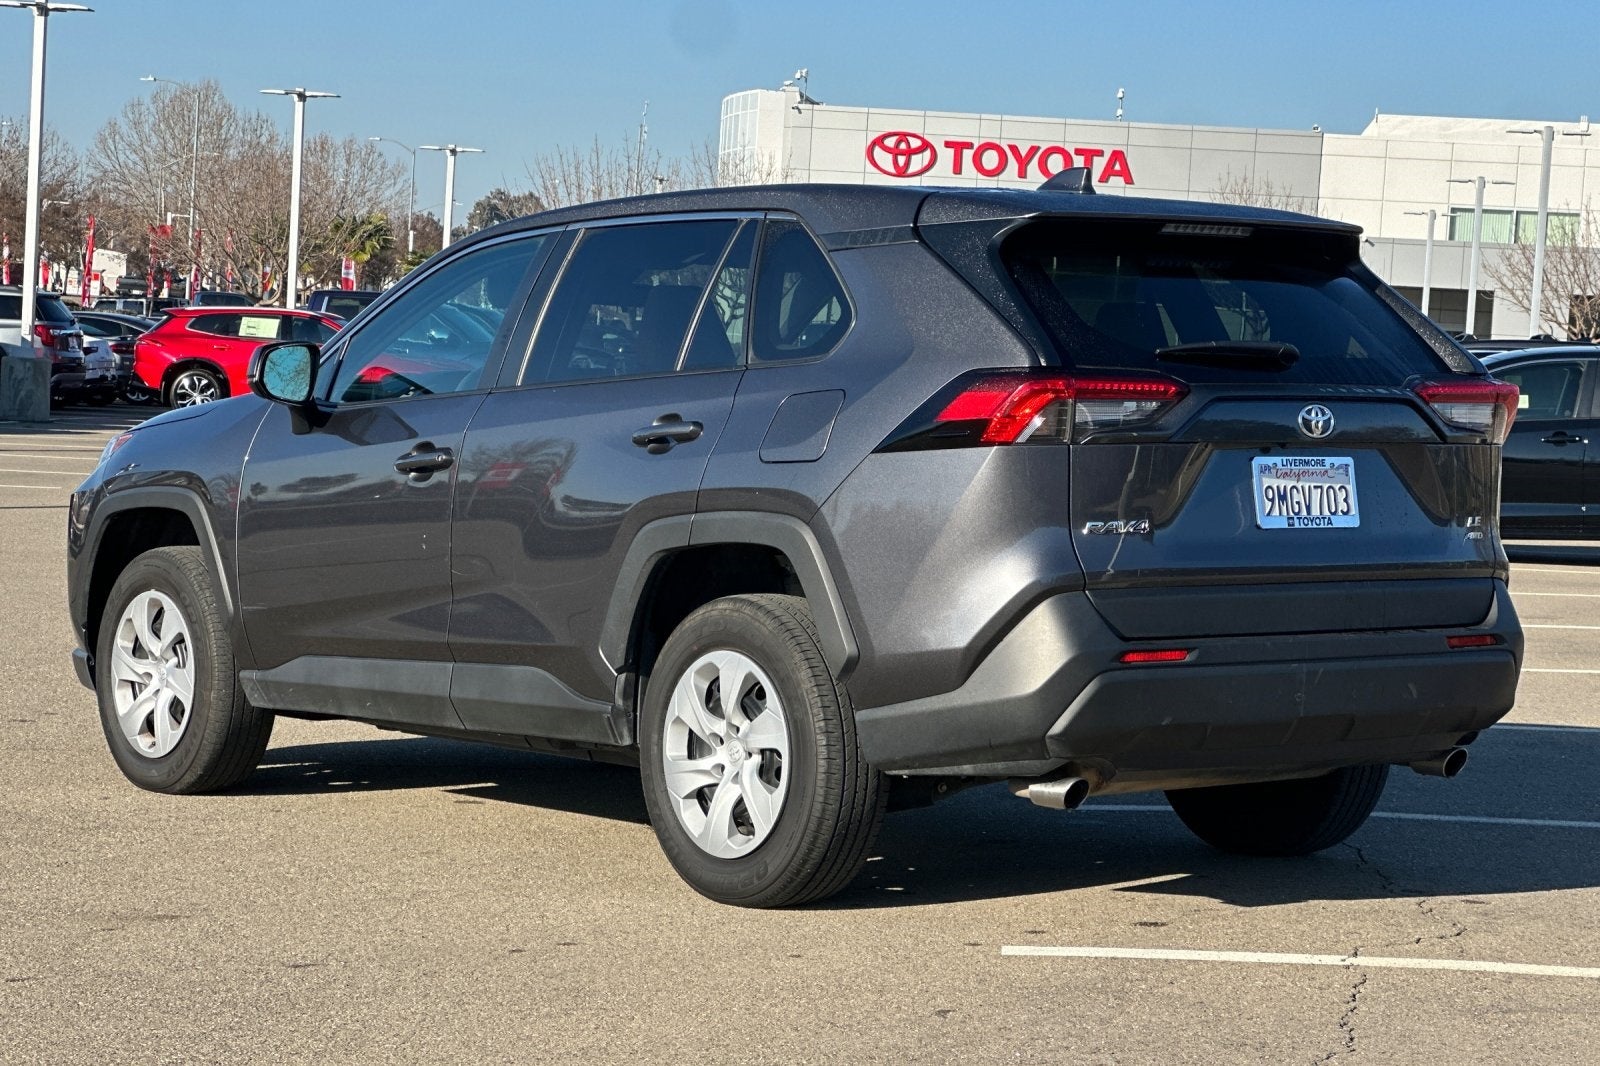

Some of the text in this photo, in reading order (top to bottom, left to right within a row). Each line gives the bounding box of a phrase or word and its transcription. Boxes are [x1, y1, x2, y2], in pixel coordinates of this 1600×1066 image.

[944, 140, 1134, 185] TOYOTA
[1282, 458, 1326, 467] LIVERMORE
[1275, 468, 1335, 482] California
[1264, 485, 1350, 516] 9MGV703
[1082, 519, 1149, 535] RAV4
[1297, 516, 1333, 526] TOYOTA
